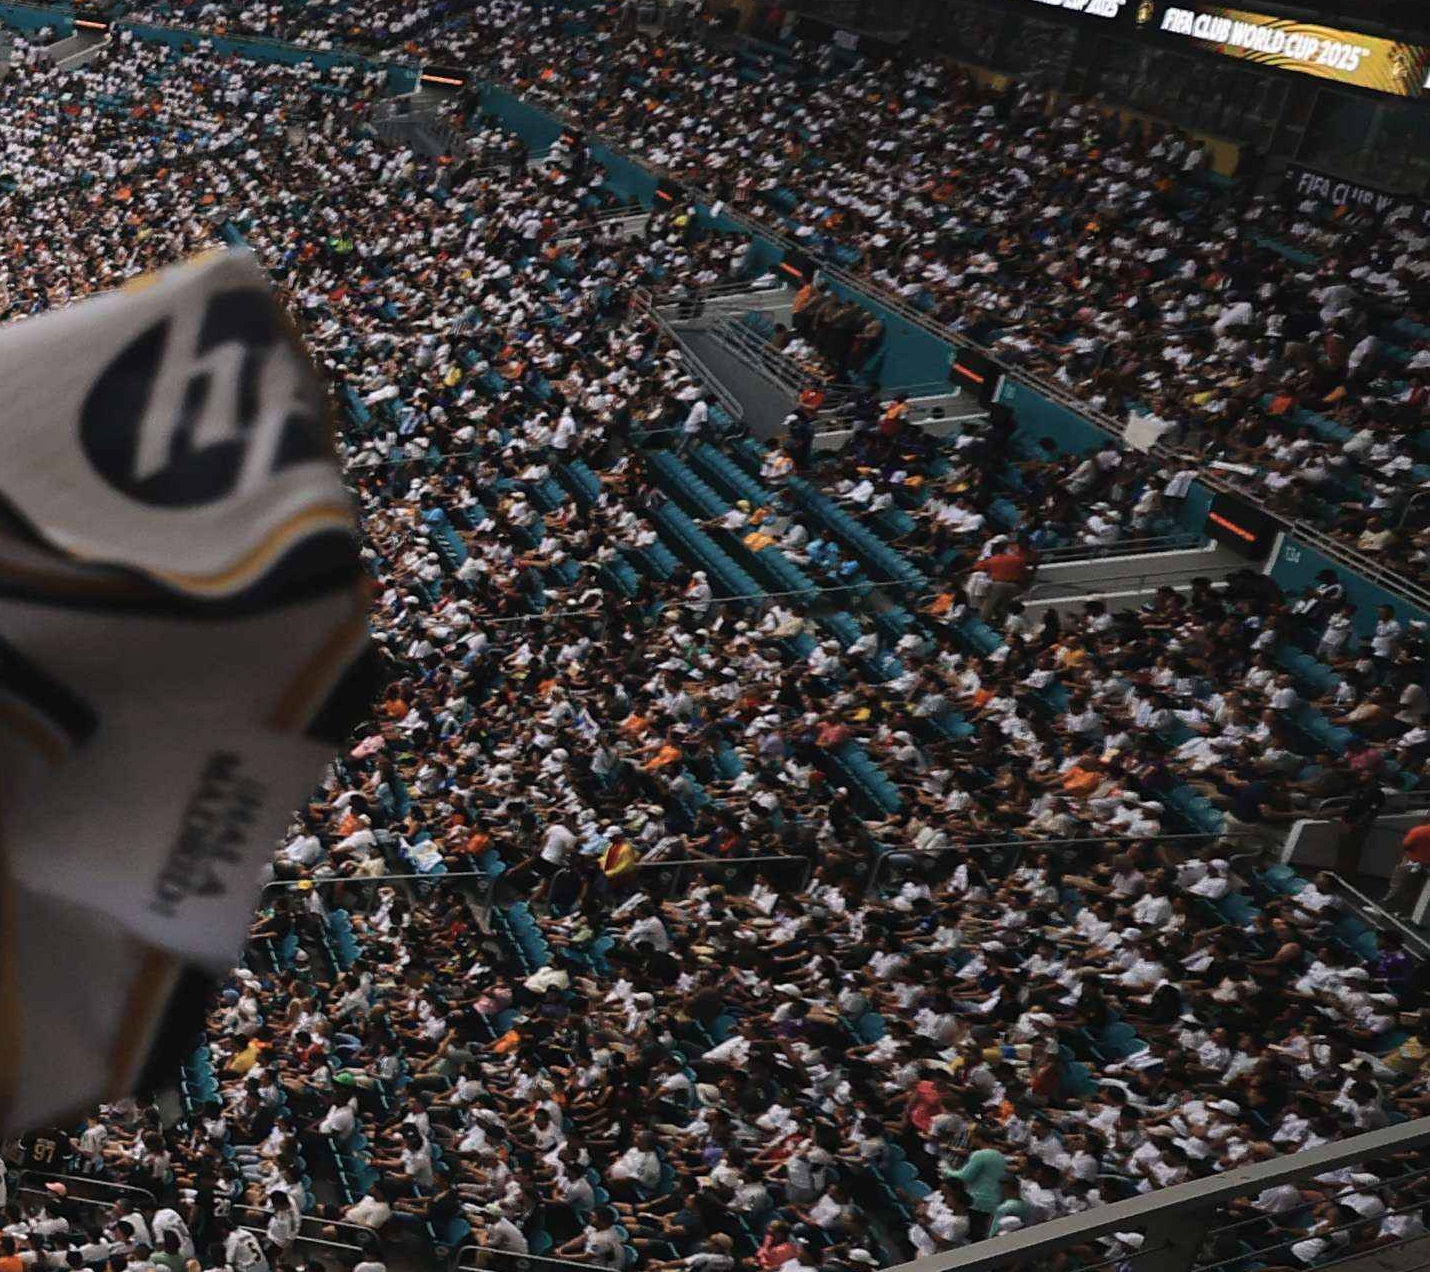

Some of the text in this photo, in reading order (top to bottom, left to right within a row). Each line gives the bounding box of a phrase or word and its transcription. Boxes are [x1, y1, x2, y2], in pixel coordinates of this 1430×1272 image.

[1160, 7, 1196, 36] FIFA
[1194, 13, 1233, 44] CLUB
[1228, 19, 1285, 54] WORLD
[1282, 32, 1320, 61] CUP
